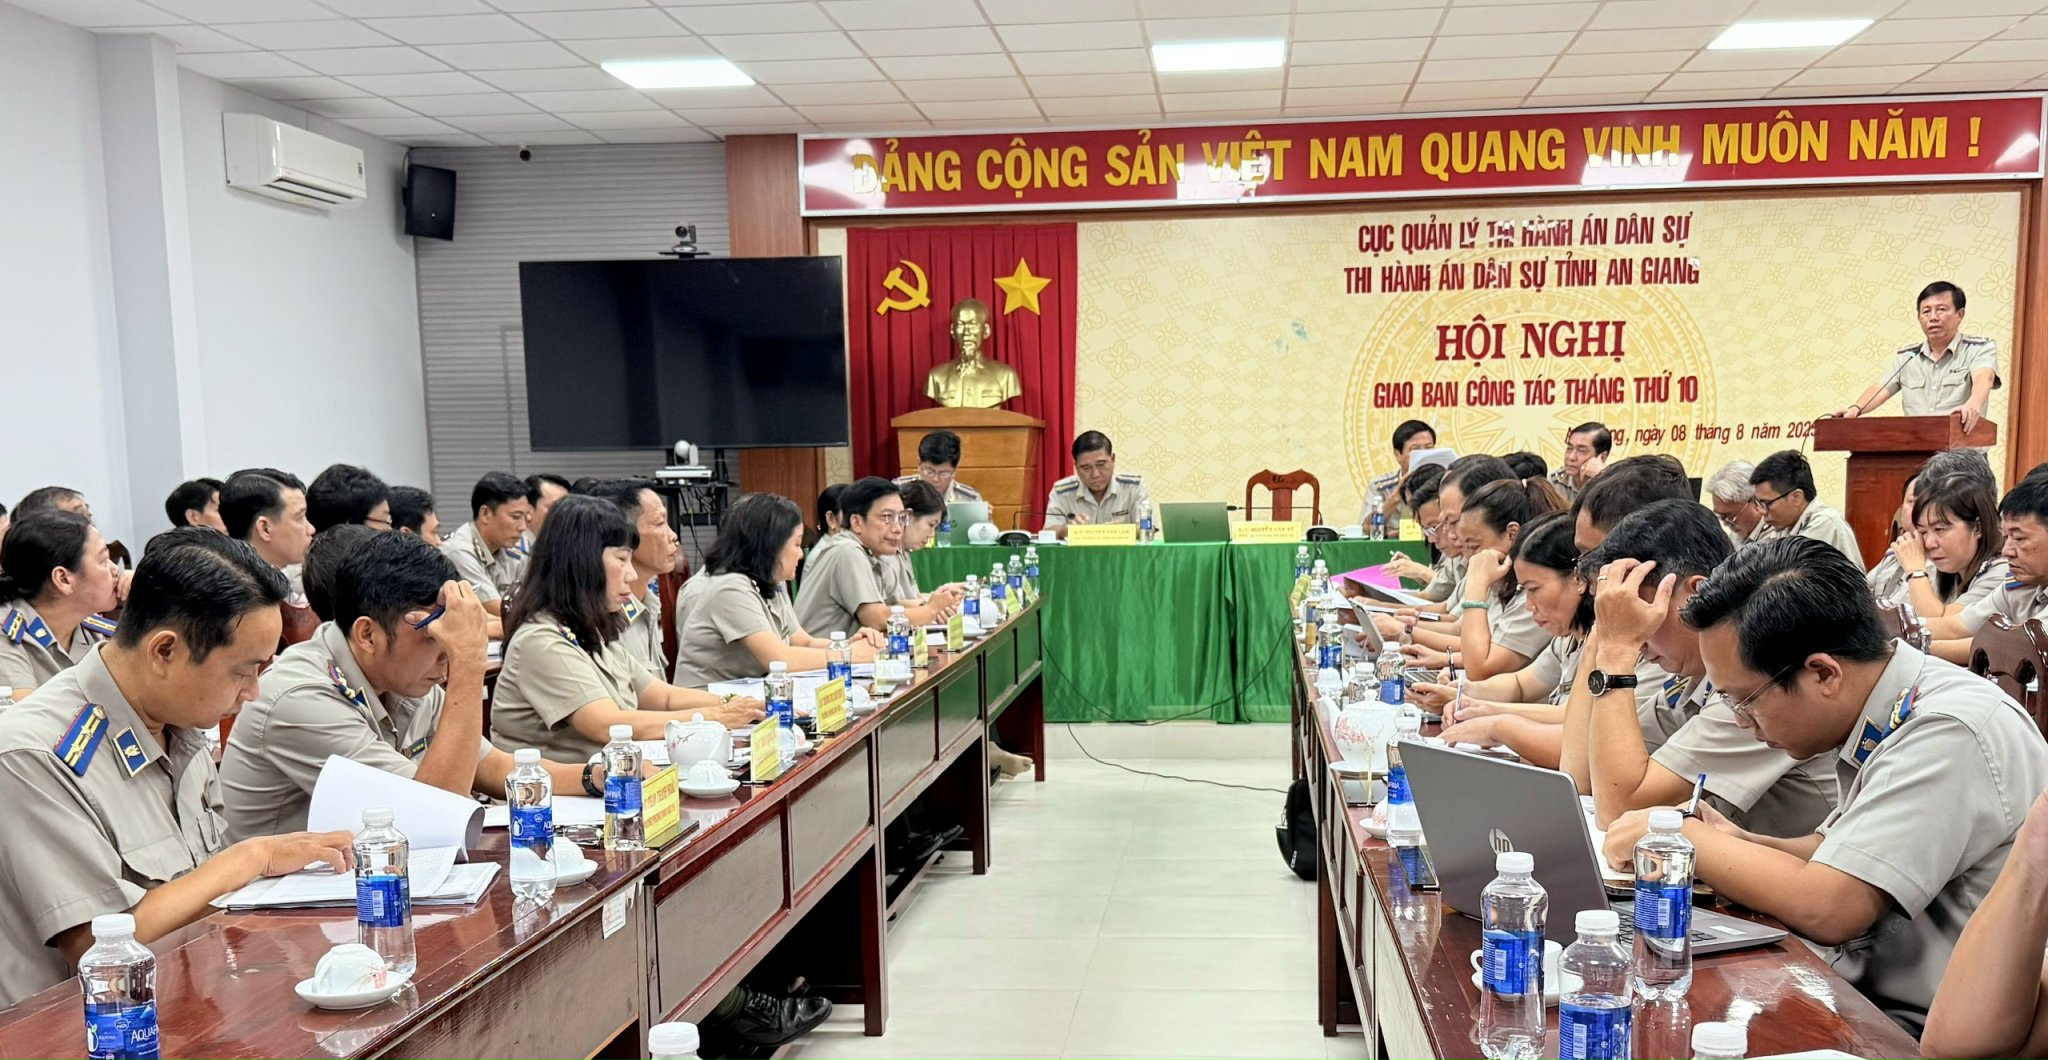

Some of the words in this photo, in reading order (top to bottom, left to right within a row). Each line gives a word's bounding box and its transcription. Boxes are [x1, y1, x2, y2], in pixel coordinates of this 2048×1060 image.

[852, 138, 962, 194] ĐẢNG
[976, 137, 1088, 199] CỘNG
[1104, 128, 1185, 187] SẢN
[1309, 133, 1403, 180] NAM
[1420, 128, 1566, 182] QUANG
[1582, 124, 1681, 168] VINH
[1702, 110, 1829, 166] MUÔN
[1848, 109, 1947, 160] NĂM
[1966, 116, 1981, 158] !
[1358, 224, 1394, 257] CỤC
[1401, 214, 1452, 254] QUẢN
[1459, 217, 1480, 249] LÝ
[1521, 215, 1573, 247] HÀNH
[1580, 213, 1608, 245] ÁN
[1615, 212, 1655, 244] DÂN
[1662, 211, 1693, 248] SỰ
[1344, 266, 1372, 294] THI
[1381, 260, 1431, 293] HÀNH
[1438, 258, 1465, 291] ÁN
[1473, 257, 1512, 289] DÂN
[1519, 256, 1548, 292] SỰ
[1555, 251, 1597, 287] TỈNH
[1606, 258, 1632, 286] AN
[1640, 257, 1700, 285] GIANG
[1435, 314, 1506, 368] HỘI
[1520, 319, 1626, 363] NGHỊ
[1373, 382, 1413, 409] GIAO
[1422, 381, 1459, 408] BAN
[1465, 375, 1515, 407] CÔNG
[1524, 372, 1555, 406] TÁC
[1564, 368, 1624, 404] THÁNG
[1633, 369, 1672, 403] THỨ
[1678, 376, 1698, 401] 10
[1635, 423, 1666, 446] ngày
[1671, 424, 1686, 442] 08
[1696, 421, 1730, 445] tháng
[1735, 423, 1745, 440] 8
[1751, 421, 1780, 440] năm
